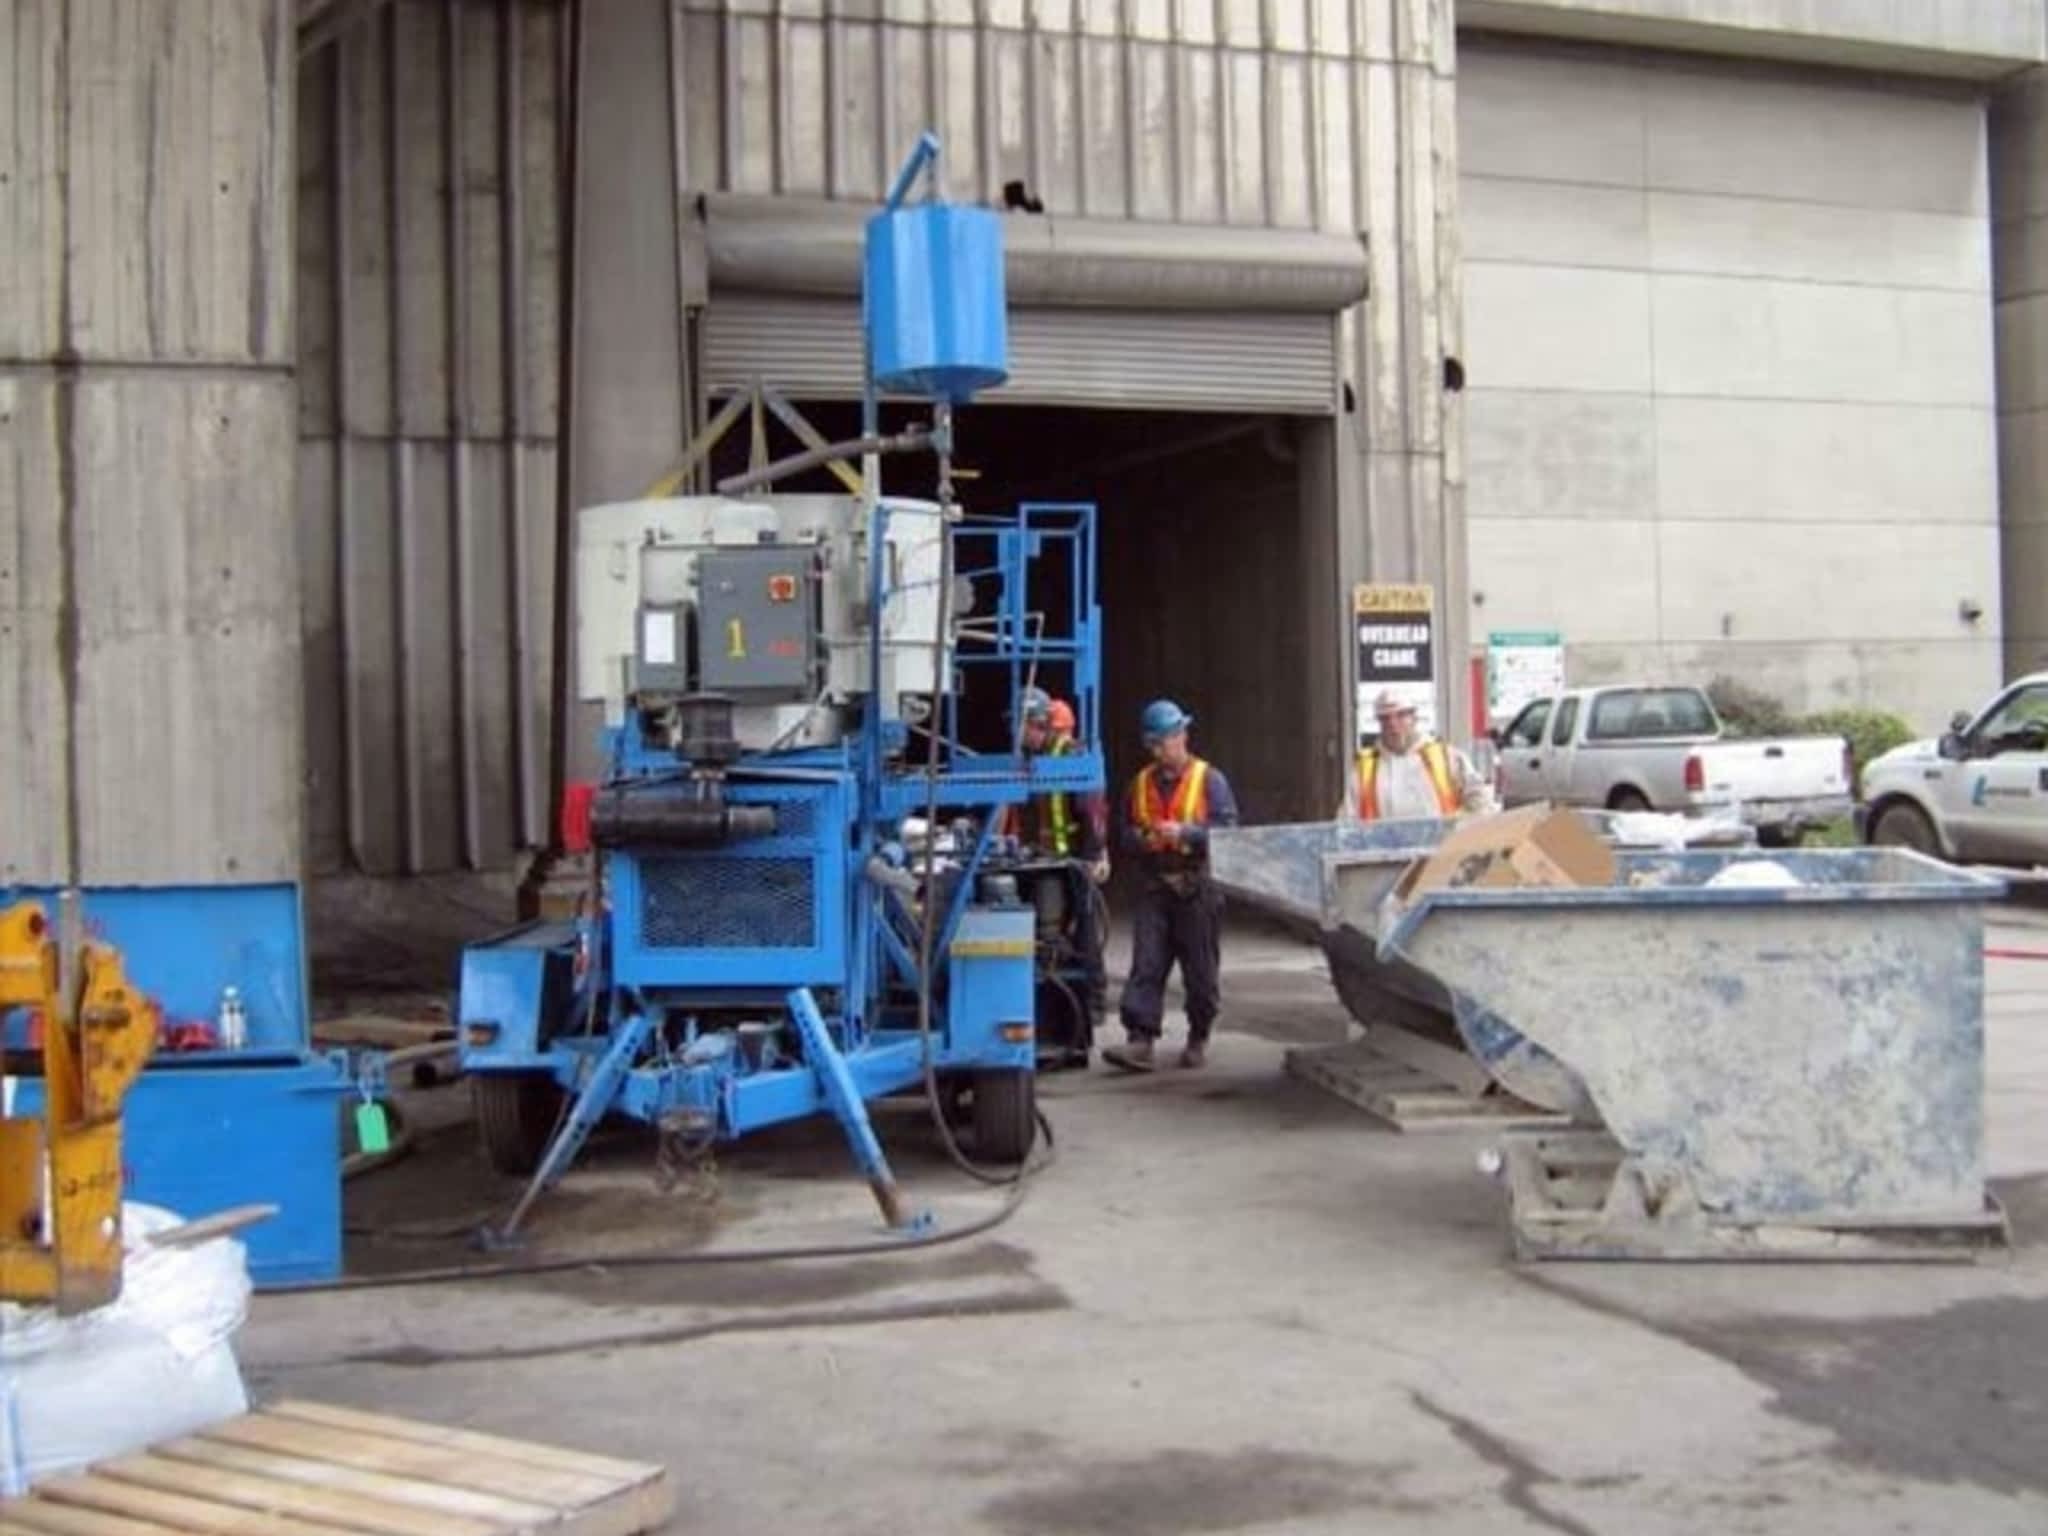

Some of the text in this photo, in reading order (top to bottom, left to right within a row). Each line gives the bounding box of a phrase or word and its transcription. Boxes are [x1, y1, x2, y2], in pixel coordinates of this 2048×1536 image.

[727, 618, 746, 658] 1
[1360, 625, 1429, 644] OVERHEAD
[1373, 648, 1418, 668] CRANE
